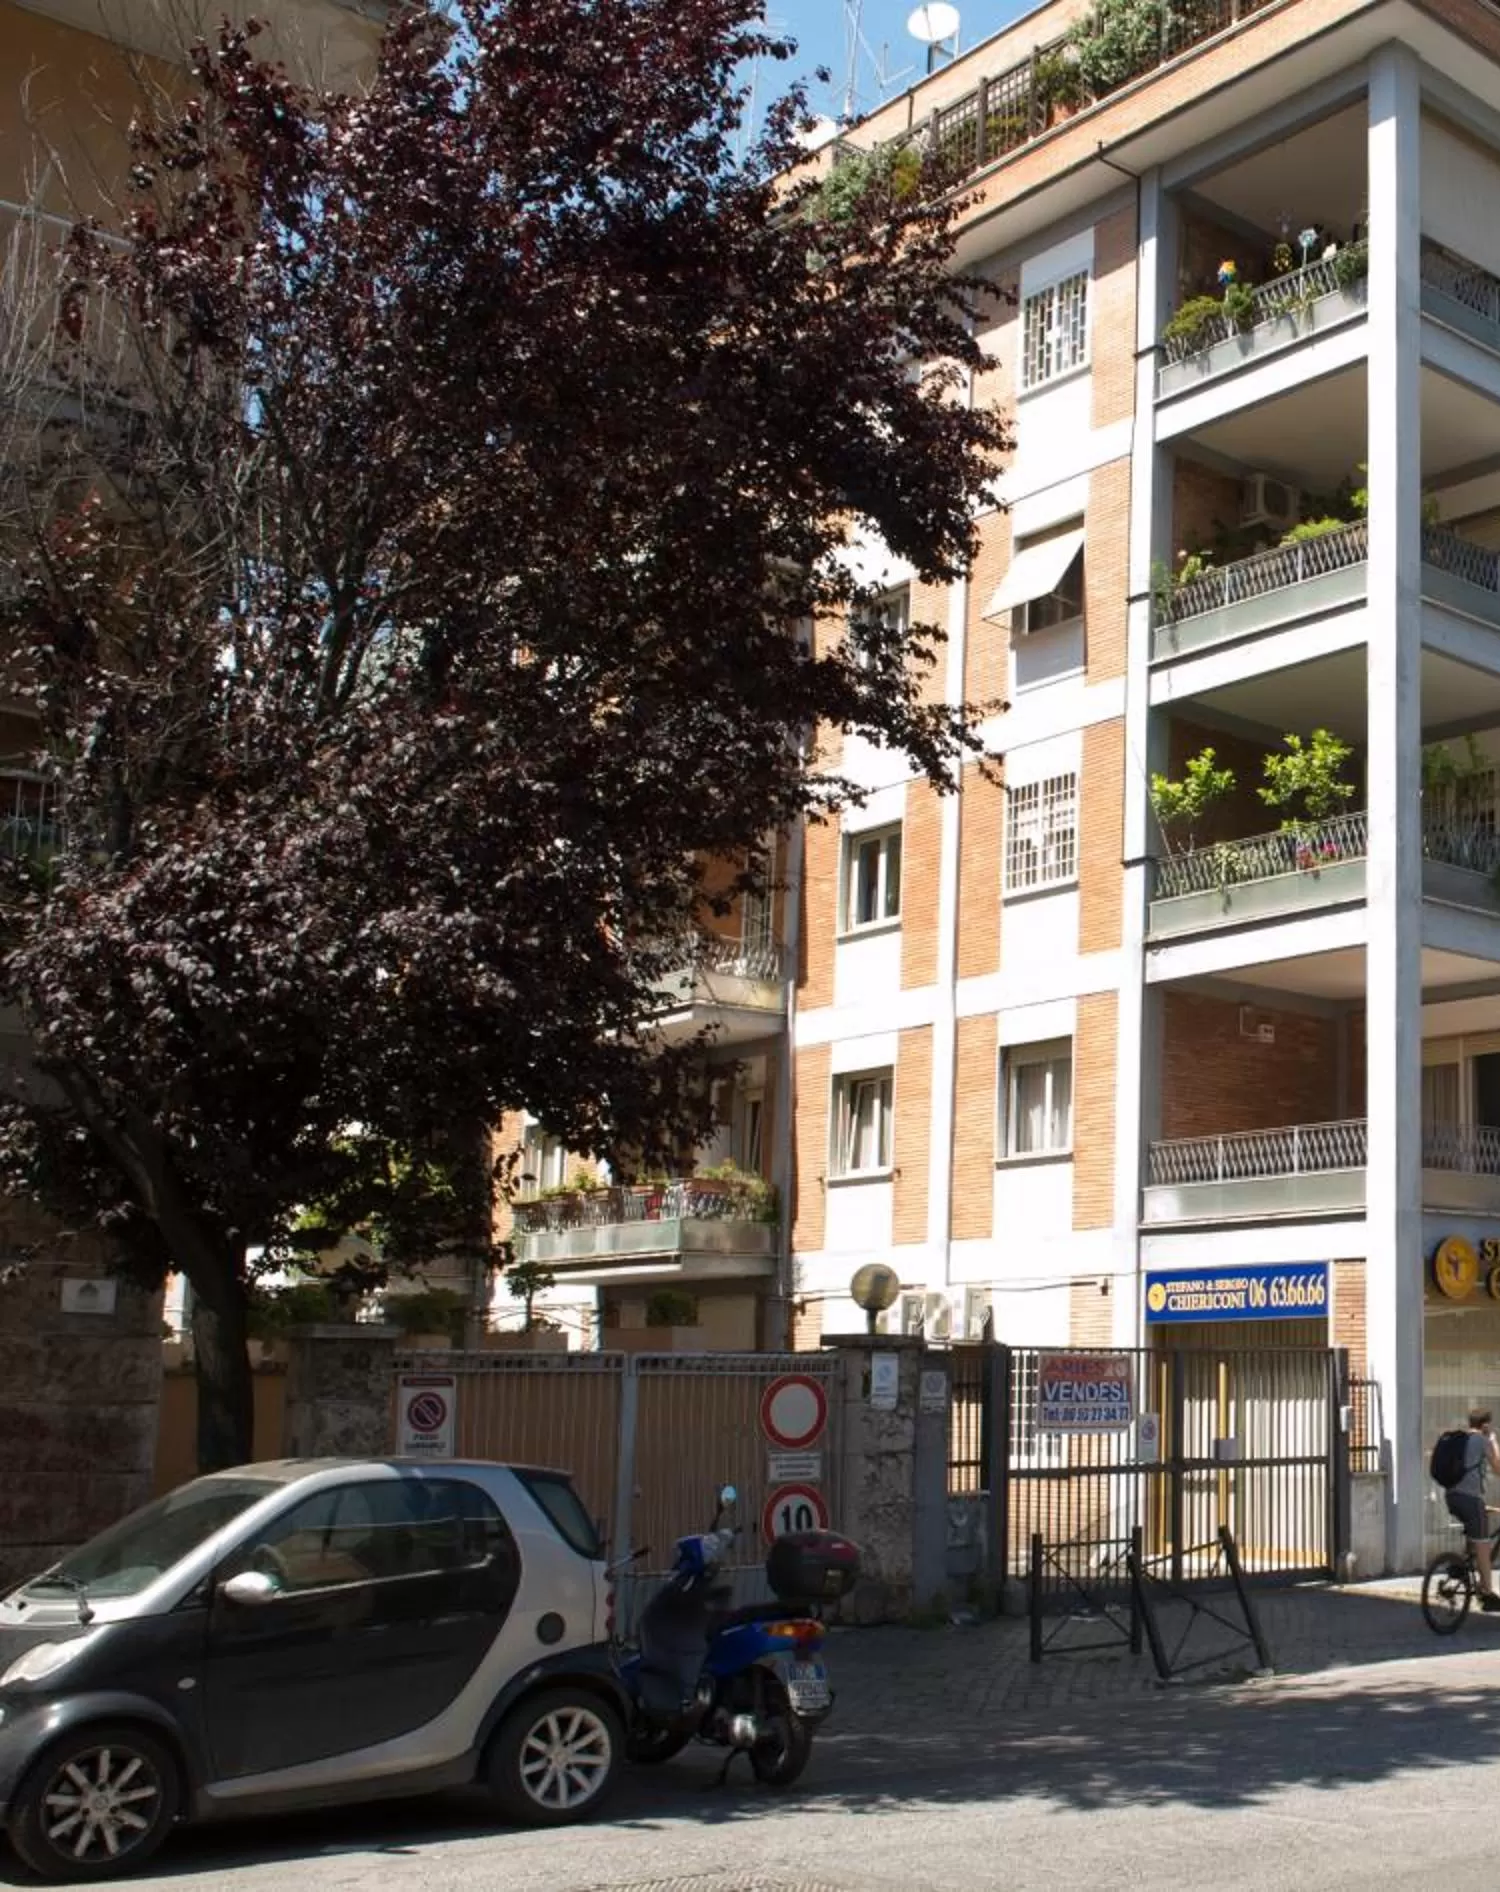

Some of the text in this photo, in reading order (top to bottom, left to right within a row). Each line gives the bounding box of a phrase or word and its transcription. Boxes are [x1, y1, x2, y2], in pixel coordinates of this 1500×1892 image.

[1165, 1281, 1204, 1293] STEFANO
[1214, 1277, 1249, 1291] SERGIO
[1250, 1276, 1266, 1308] 06
[1168, 1291, 1246, 1311] CHIERICONI
[1043, 1381, 1127, 1401] VENDESI
[782, 1503, 813, 1533] 10
